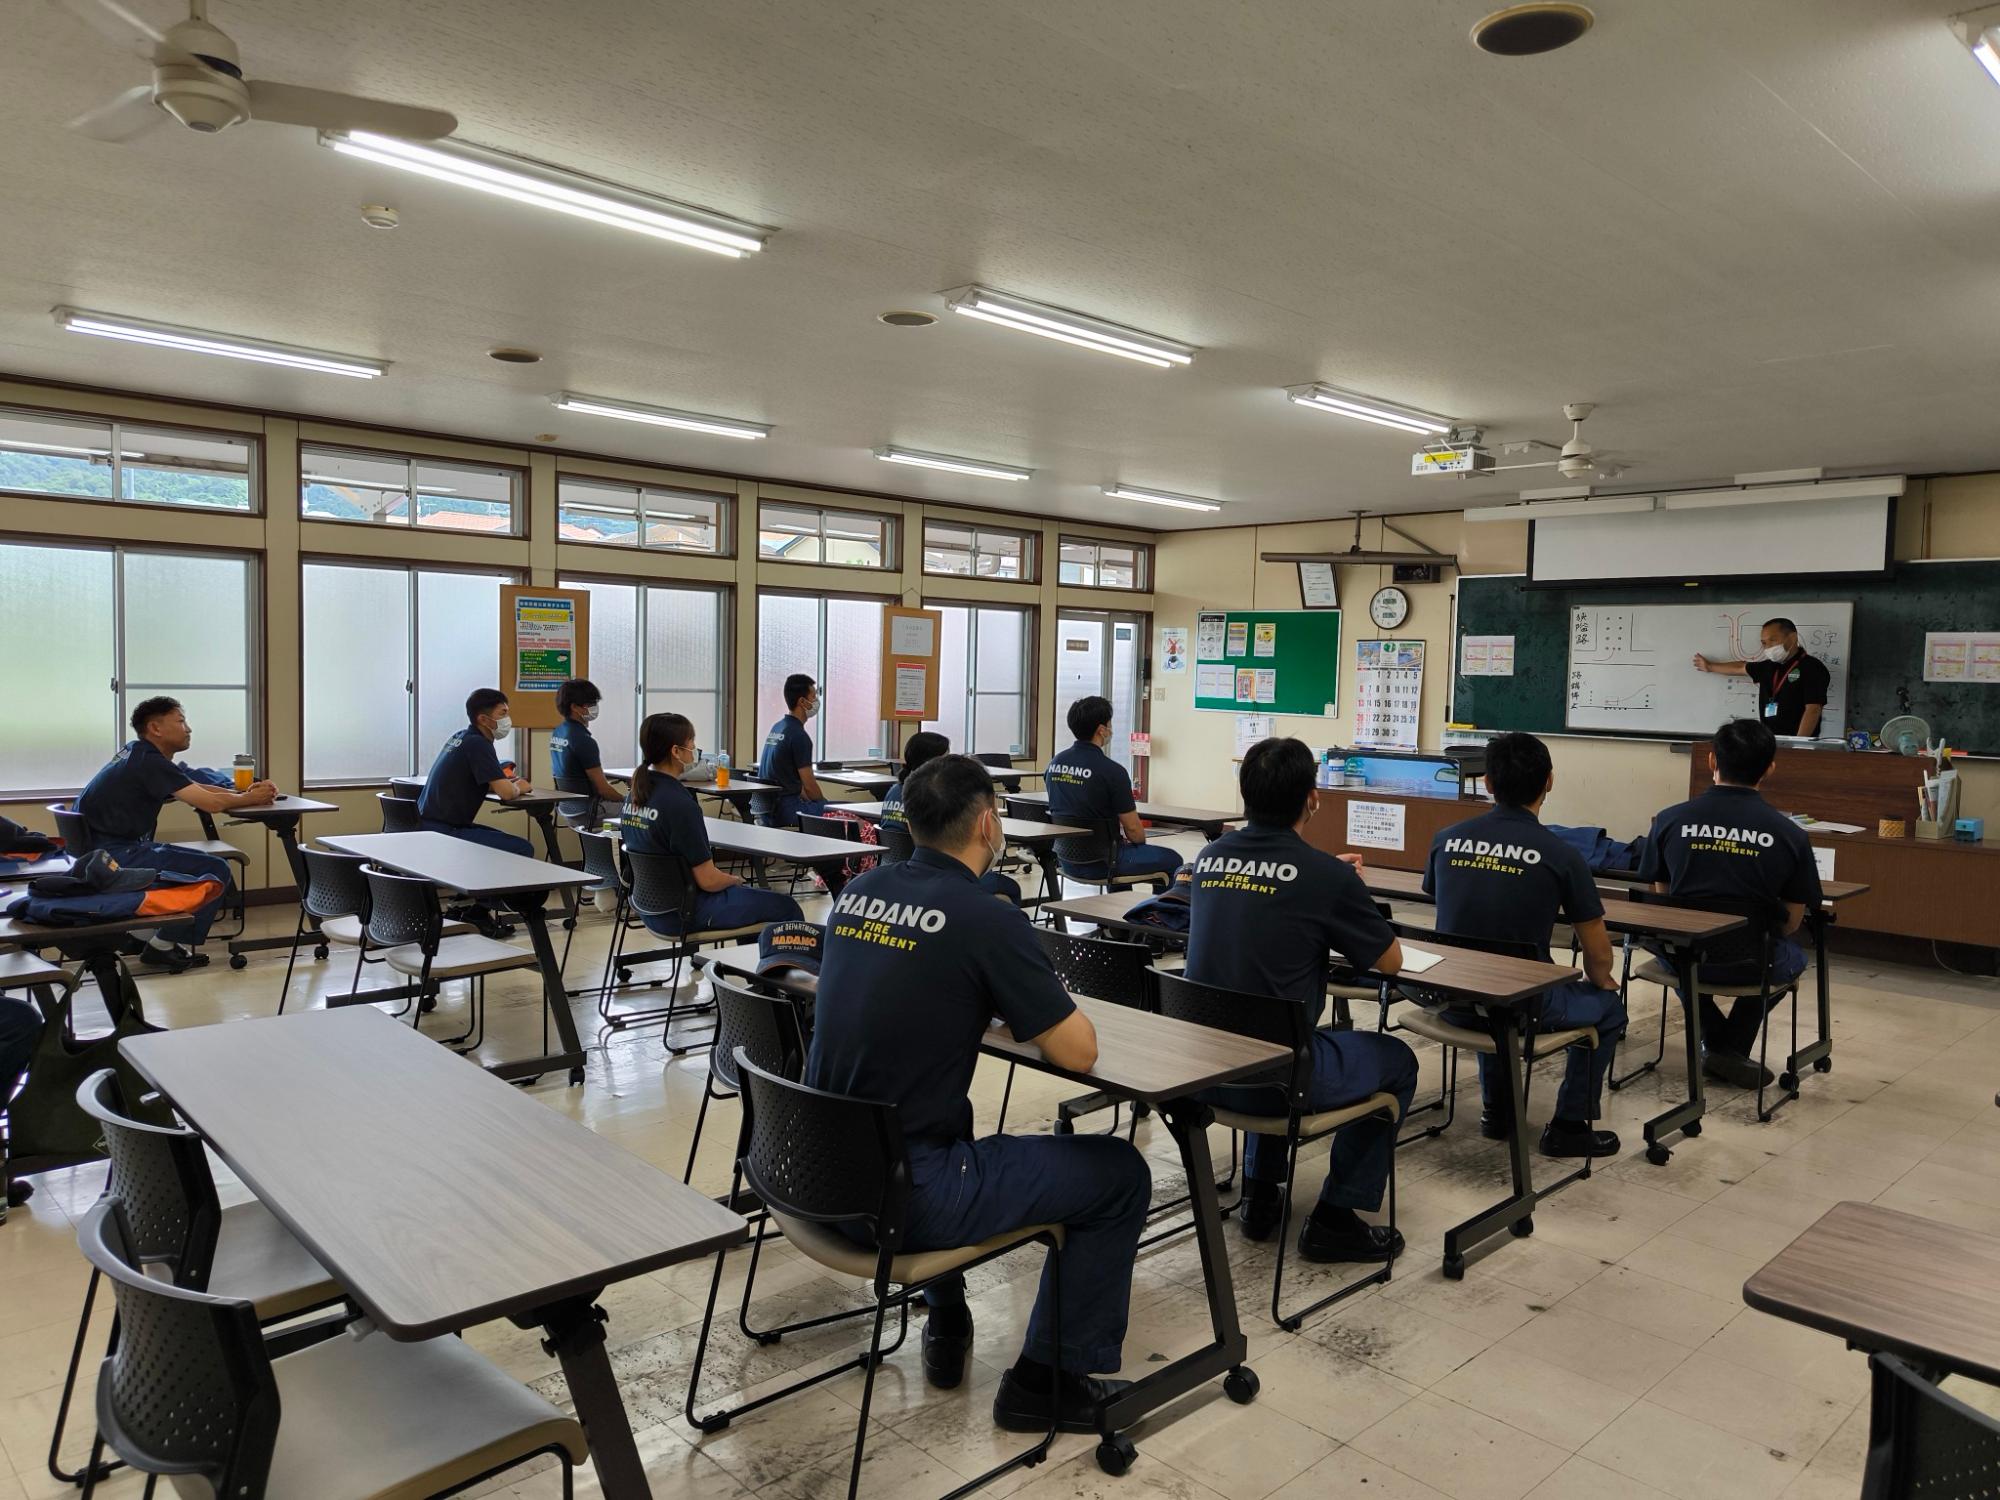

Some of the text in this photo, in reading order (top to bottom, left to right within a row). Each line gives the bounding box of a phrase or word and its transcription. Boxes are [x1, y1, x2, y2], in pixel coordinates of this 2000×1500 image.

[1413, 671, 1418, 680] 5
[1411, 686, 1418, 695] 12
[1374, 699, 1381, 707] 15
[1384, 699, 1392, 708] 16
[1373, 713, 1380, 722] 22
[1382, 714, 1391, 722] 23
[1372, 728, 1379, 736] 29
[1381, 728, 1390, 737] 30
[1048, 763, 1092, 778] HADANO
[1681, 823, 1775, 848] HADANO
[1691, 843, 1760, 857] DEPARTMENT
[1715, 839, 1738, 848] FIRE
[1444, 838, 1541, 865] HADANO
[1475, 855, 1500, 865] FIRE
[1196, 856, 1299, 882] HADANO
[1451, 859, 1524, 876] DEPARTMENT
[1224, 874, 1251, 883] FIRE
[1201, 880, 1277, 895] DEPARTMENT
[834, 893, 947, 934] HADANO
[862, 920, 891, 936] FIRE
[772, 935, 817, 948] HADANO
[835, 926, 917, 951] DEPARTMENT
